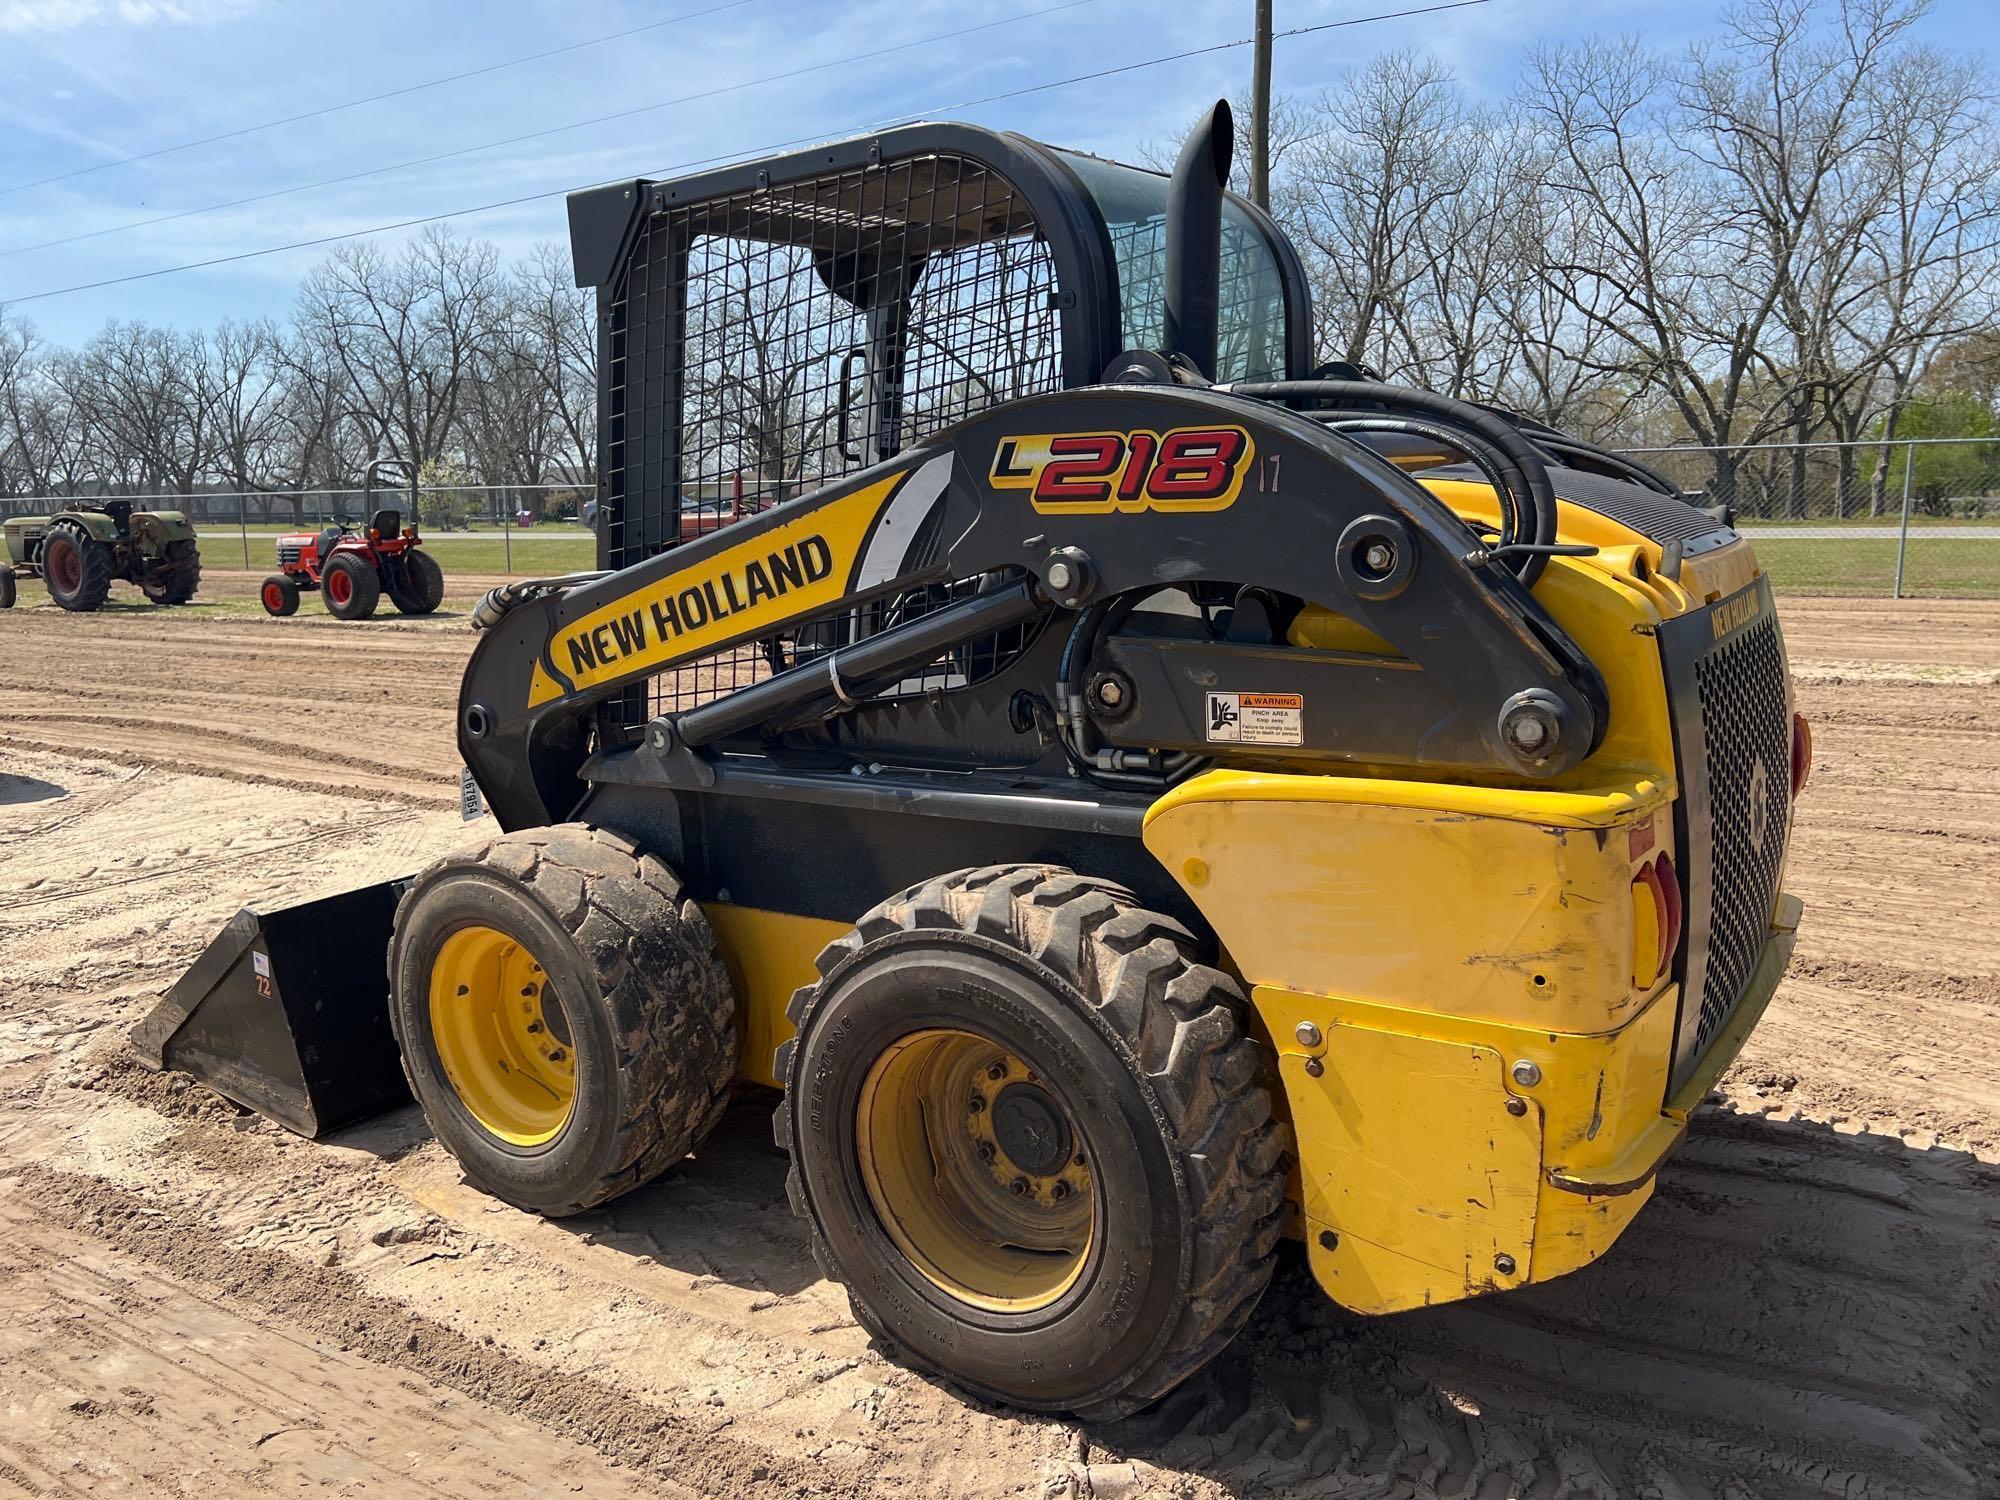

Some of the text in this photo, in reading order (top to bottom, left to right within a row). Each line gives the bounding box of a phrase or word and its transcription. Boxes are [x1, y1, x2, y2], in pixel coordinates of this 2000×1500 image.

[993, 428, 1248, 504] L218
[566, 533, 833, 676] NEW HOLLAND
[1711, 587, 1760, 640] NEW HOLLAND
[1254, 698, 1297, 706] WARNING
